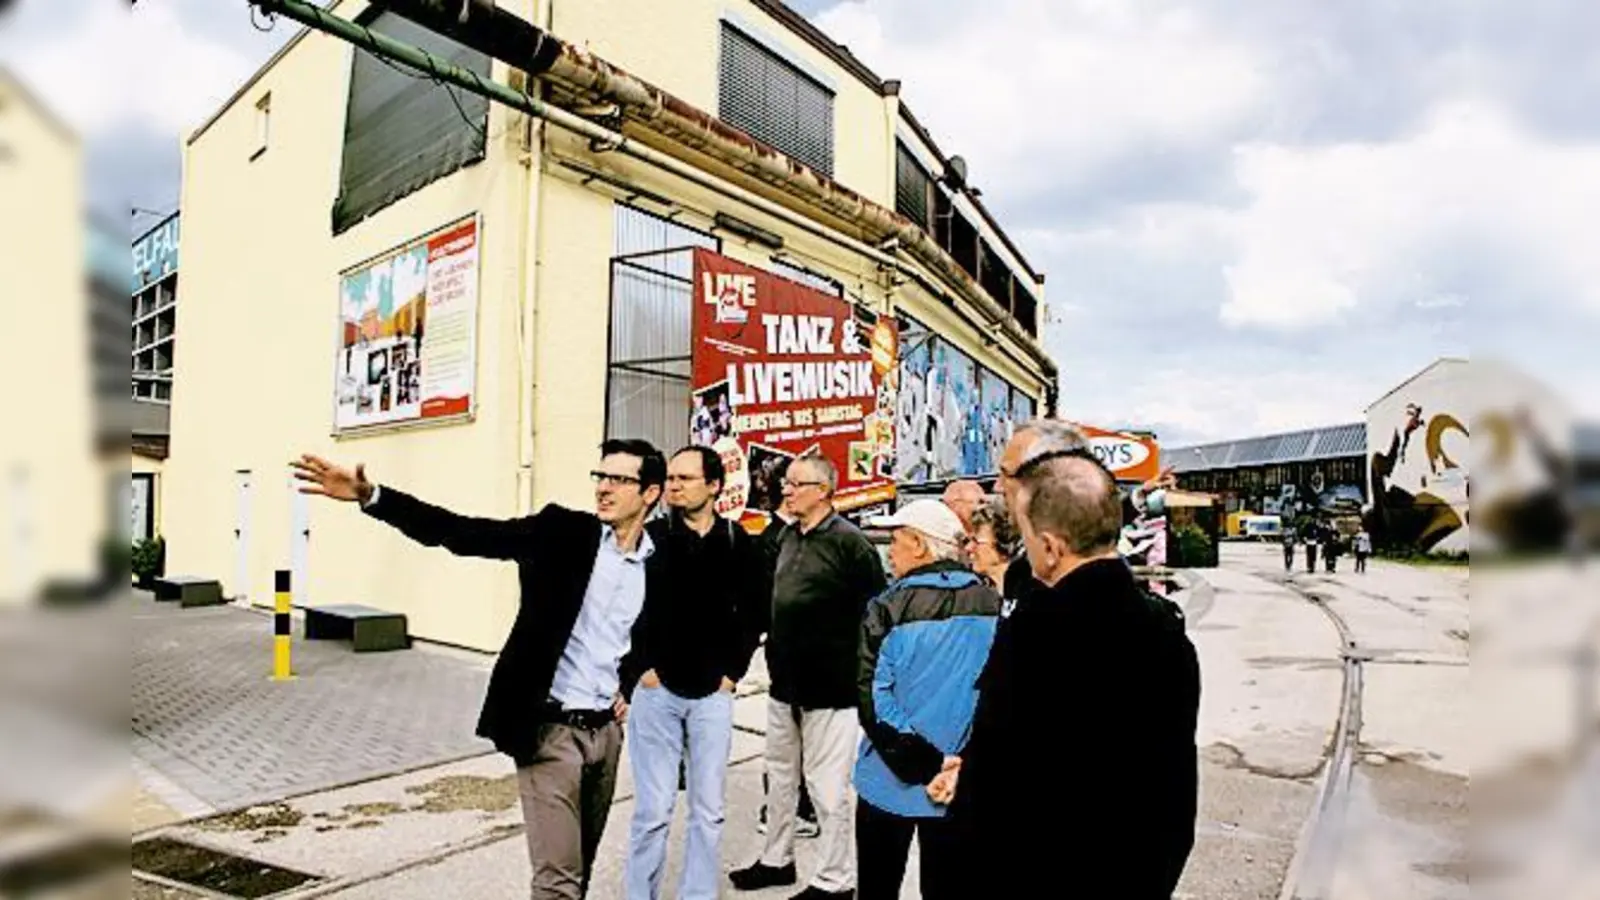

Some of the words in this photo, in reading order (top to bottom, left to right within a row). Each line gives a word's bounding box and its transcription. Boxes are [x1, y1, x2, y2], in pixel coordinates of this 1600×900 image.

[762, 314, 834, 354] TANZ
[841, 319, 860, 353] &
[726, 362, 875, 404] LIVEMUSIK
